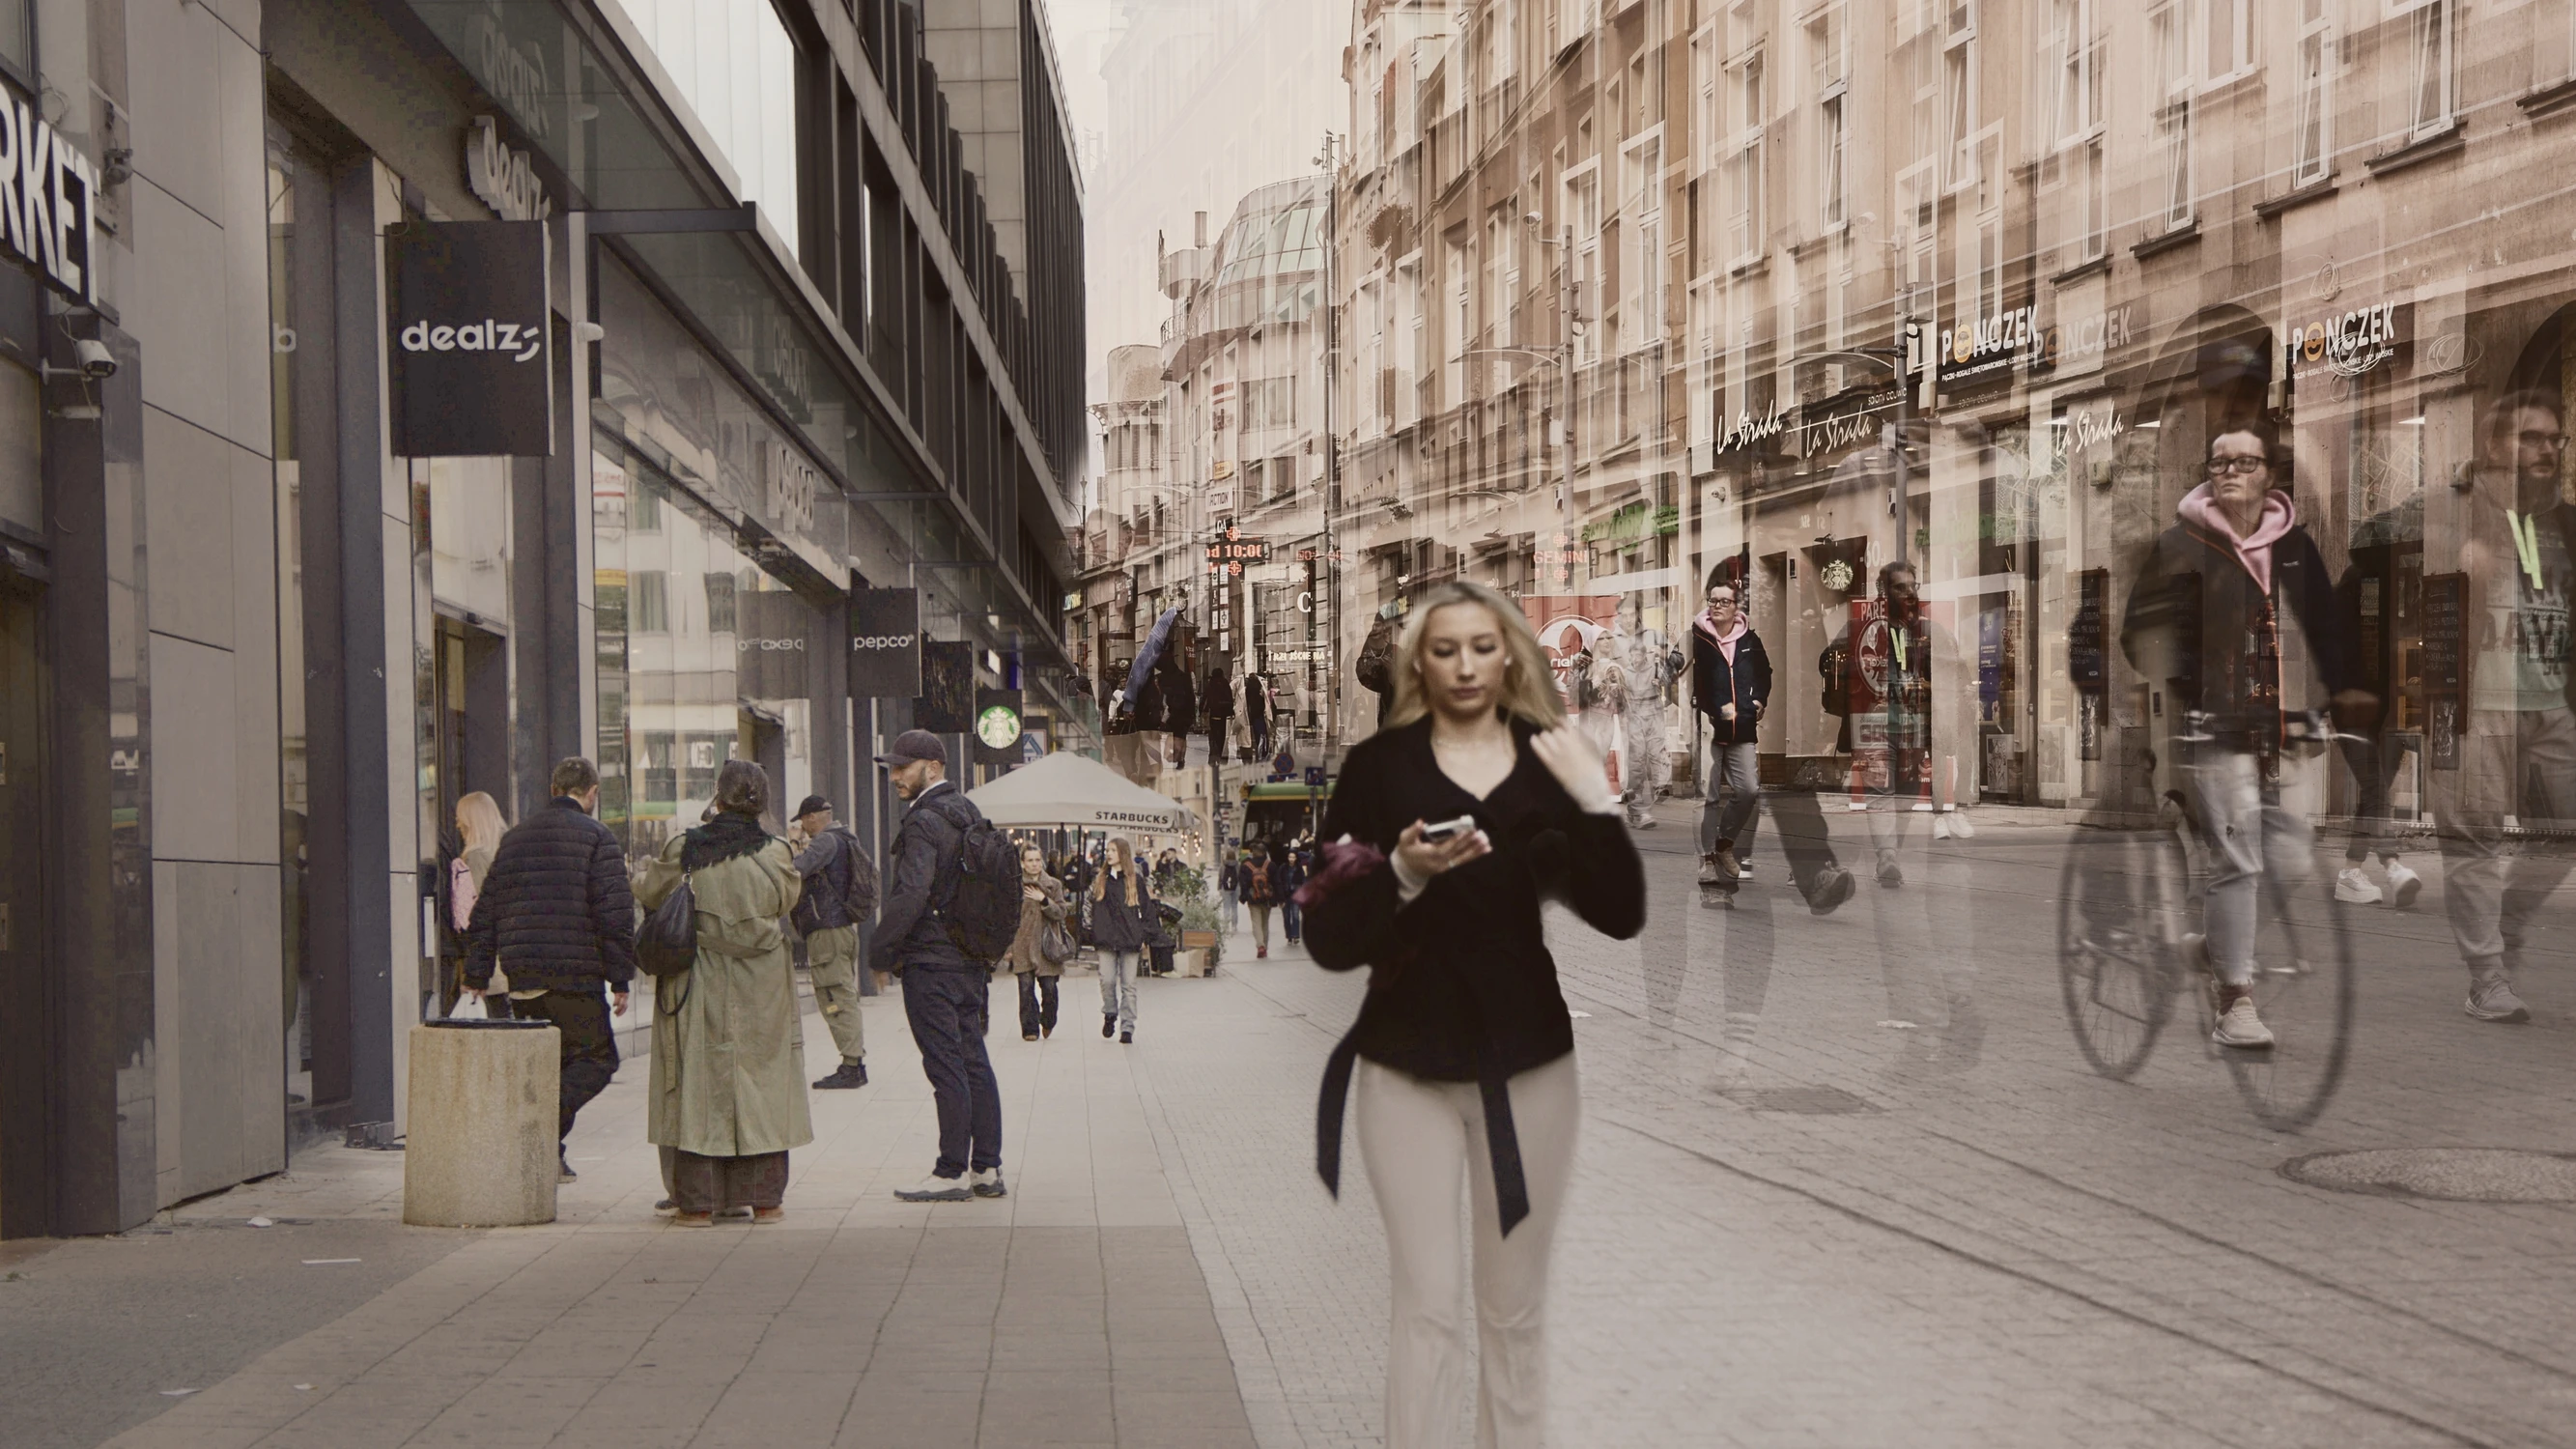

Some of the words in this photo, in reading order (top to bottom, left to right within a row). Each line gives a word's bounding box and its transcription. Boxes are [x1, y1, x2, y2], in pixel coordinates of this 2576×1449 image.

[1941, 303, 2038, 366] PONCZEK
[1736, 399, 1783, 451] Strada
[1534, 550, 1588, 564] GEMINI
[1095, 810, 1169, 825] STARBUCKS
